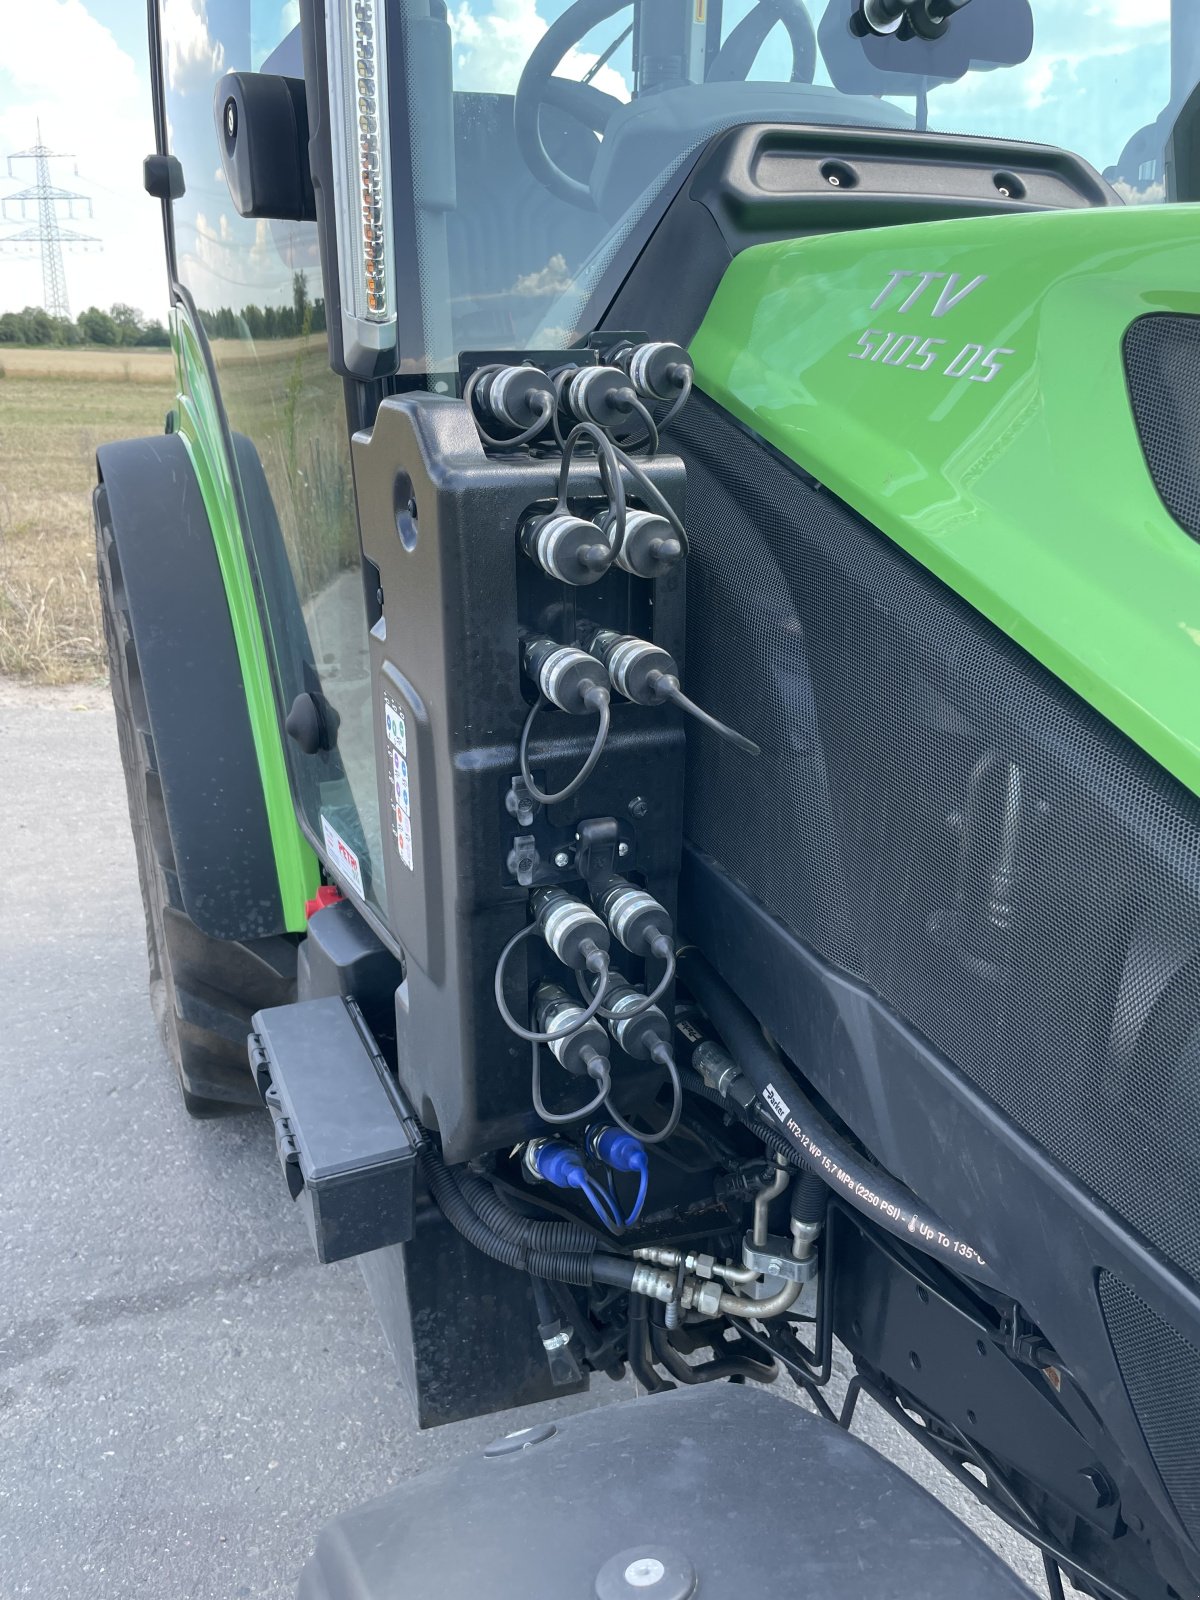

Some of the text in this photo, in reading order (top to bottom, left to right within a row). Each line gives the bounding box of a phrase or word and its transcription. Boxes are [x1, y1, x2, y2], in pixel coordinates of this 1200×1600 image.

[870, 269, 988, 317] TTV
[848, 328, 948, 371] 5105
[764, 1086, 787, 1119] Parker
[786, 1117, 810, 1148] HT2-12
[808, 1141, 822, 1158] WP
[821, 1155, 838, 1174] 15,7
[836, 1168, 855, 1190] MPa
[855, 1182, 880, 1207] (2250
[879, 1200, 901, 1221] PSI)
[919, 1222, 934, 1240] Up
[937, 1231, 950, 1248] To
